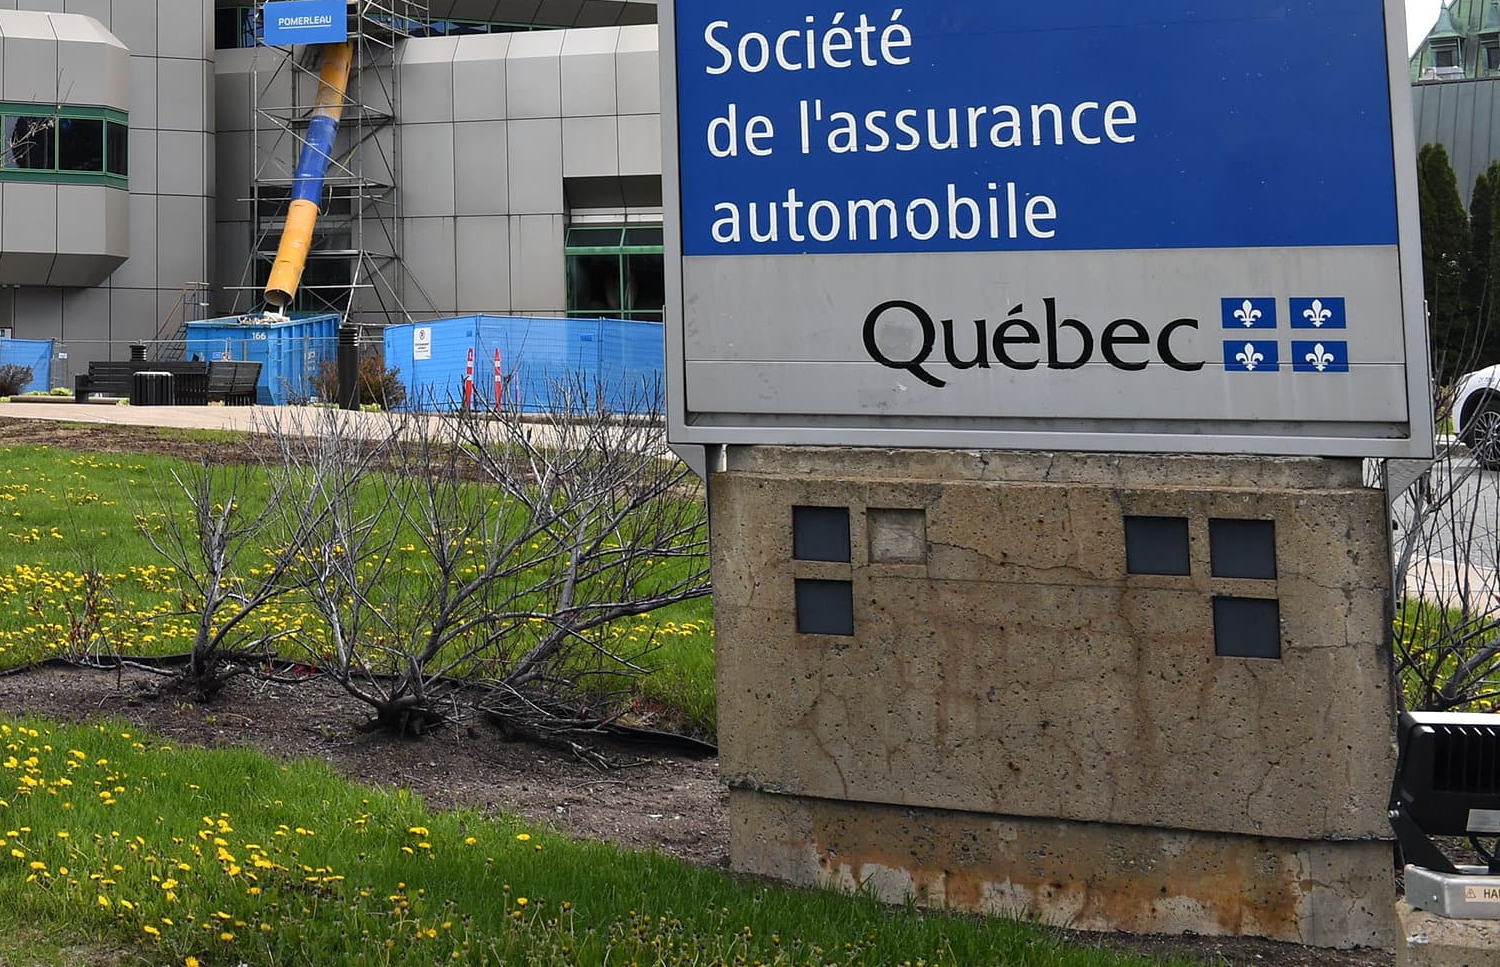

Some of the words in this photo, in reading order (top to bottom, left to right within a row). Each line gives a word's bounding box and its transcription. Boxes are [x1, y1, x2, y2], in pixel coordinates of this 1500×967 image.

[278, 15, 332, 26] POMERLEAU
[704, 8, 912, 75] Société
[707, 103, 774, 158] de
[800, 99, 1137, 154] l'assurance
[711, 182, 1057, 243] automobile
[252, 332, 267, 341] 166
[862, 297, 1206, 388] Québec
[1483, 888, 1500, 899] HA
